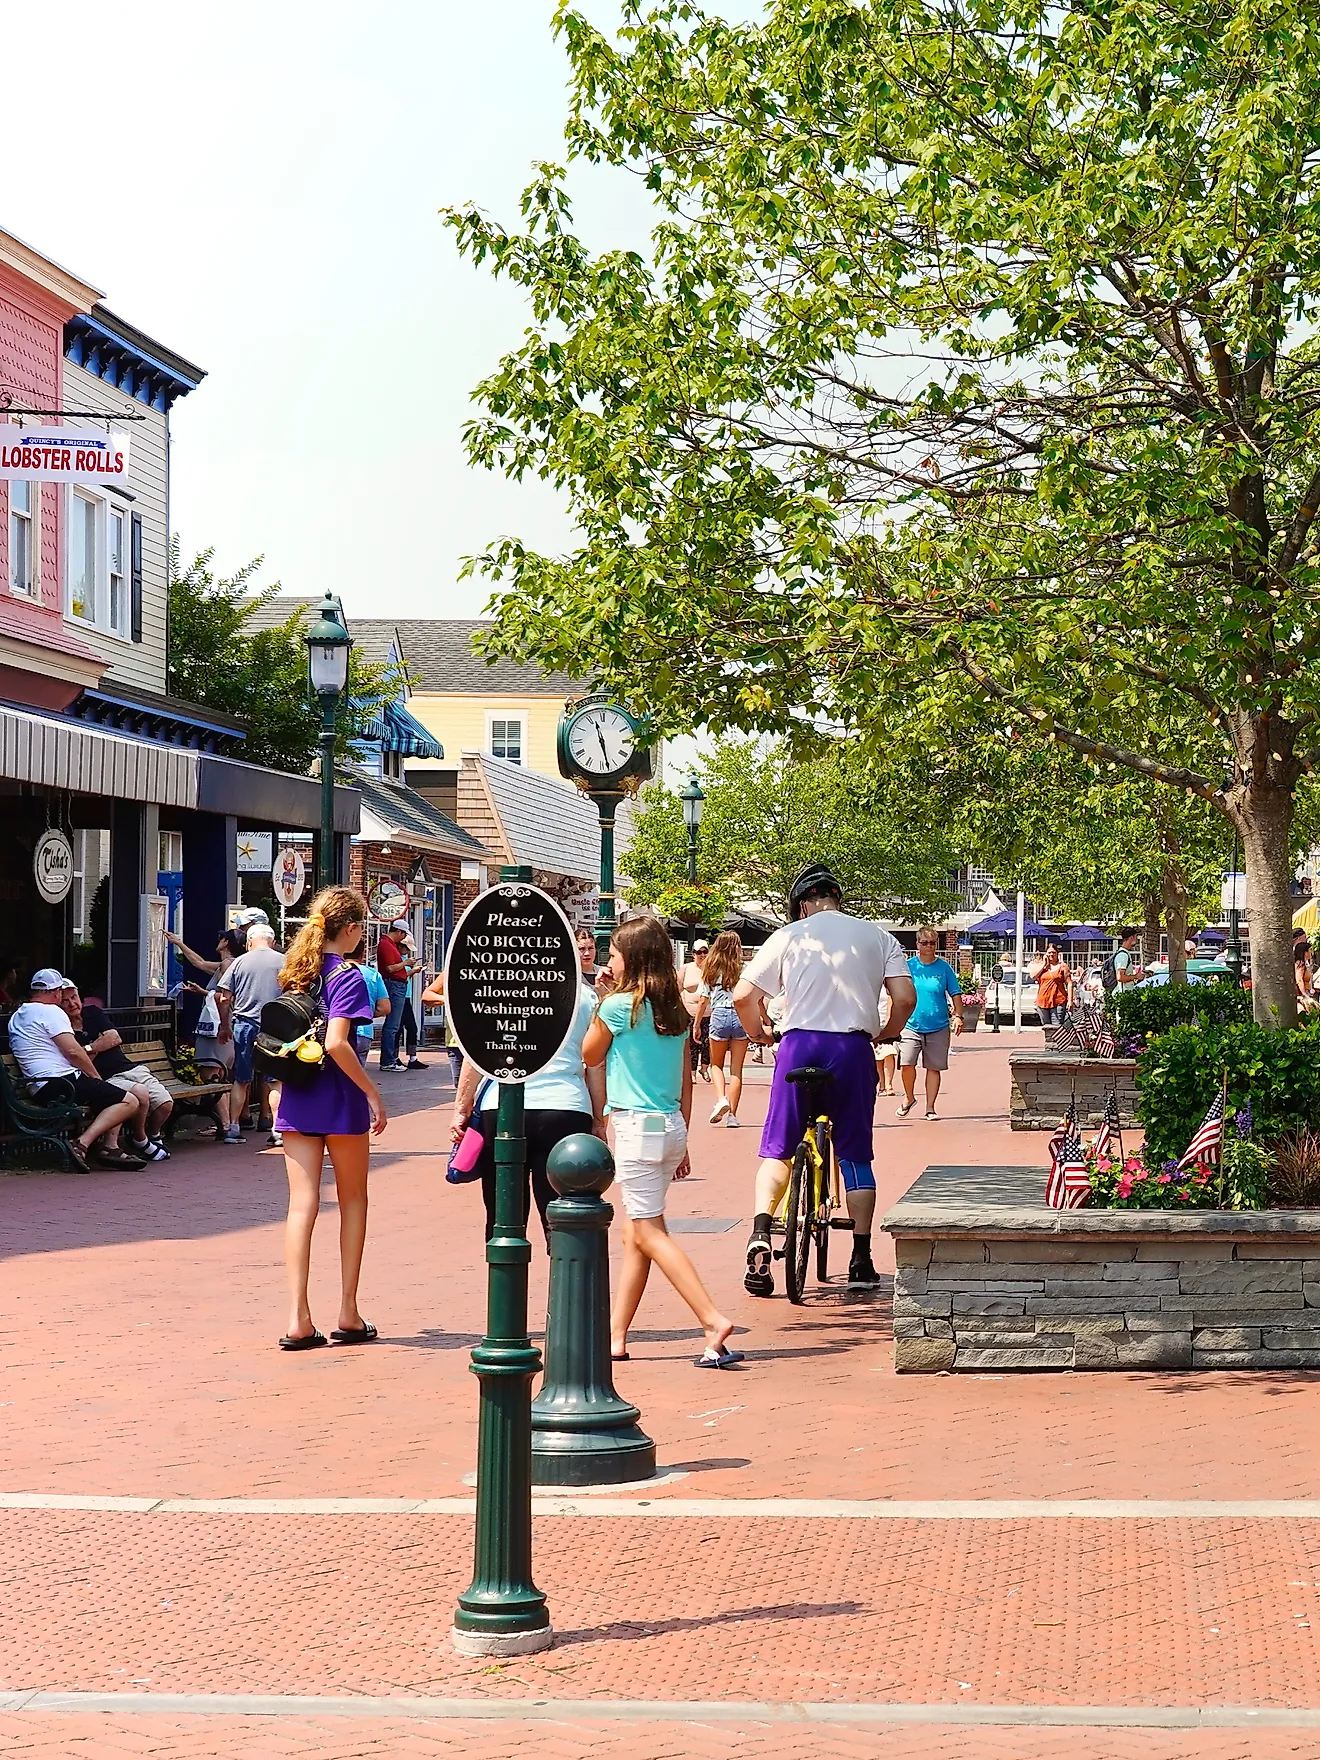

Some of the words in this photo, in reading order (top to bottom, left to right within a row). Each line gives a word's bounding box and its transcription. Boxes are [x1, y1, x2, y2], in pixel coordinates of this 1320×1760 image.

[28, 437, 61, 445] QUINCY'S
[2, 446, 71, 471] LOBSTER
[75, 450, 124, 473] ROLLS
[486, 912, 543, 927] Please!
[466, 935, 489, 947] NO
[493, 936, 561, 949] BICYCLES
[470, 952, 493, 964] NO
[496, 953, 539, 965] DOGS
[541, 956, 556, 965] or
[459, 968, 566, 982] SKATEBOARDS
[474, 985, 528, 998] allowed
[531, 989, 550, 999] on
[470, 1002, 554, 1018] Washington
[496, 1020, 527, 1032] Mall
[485, 1041, 518, 1051] Thank
[518, 1043, 537, 1052] you
